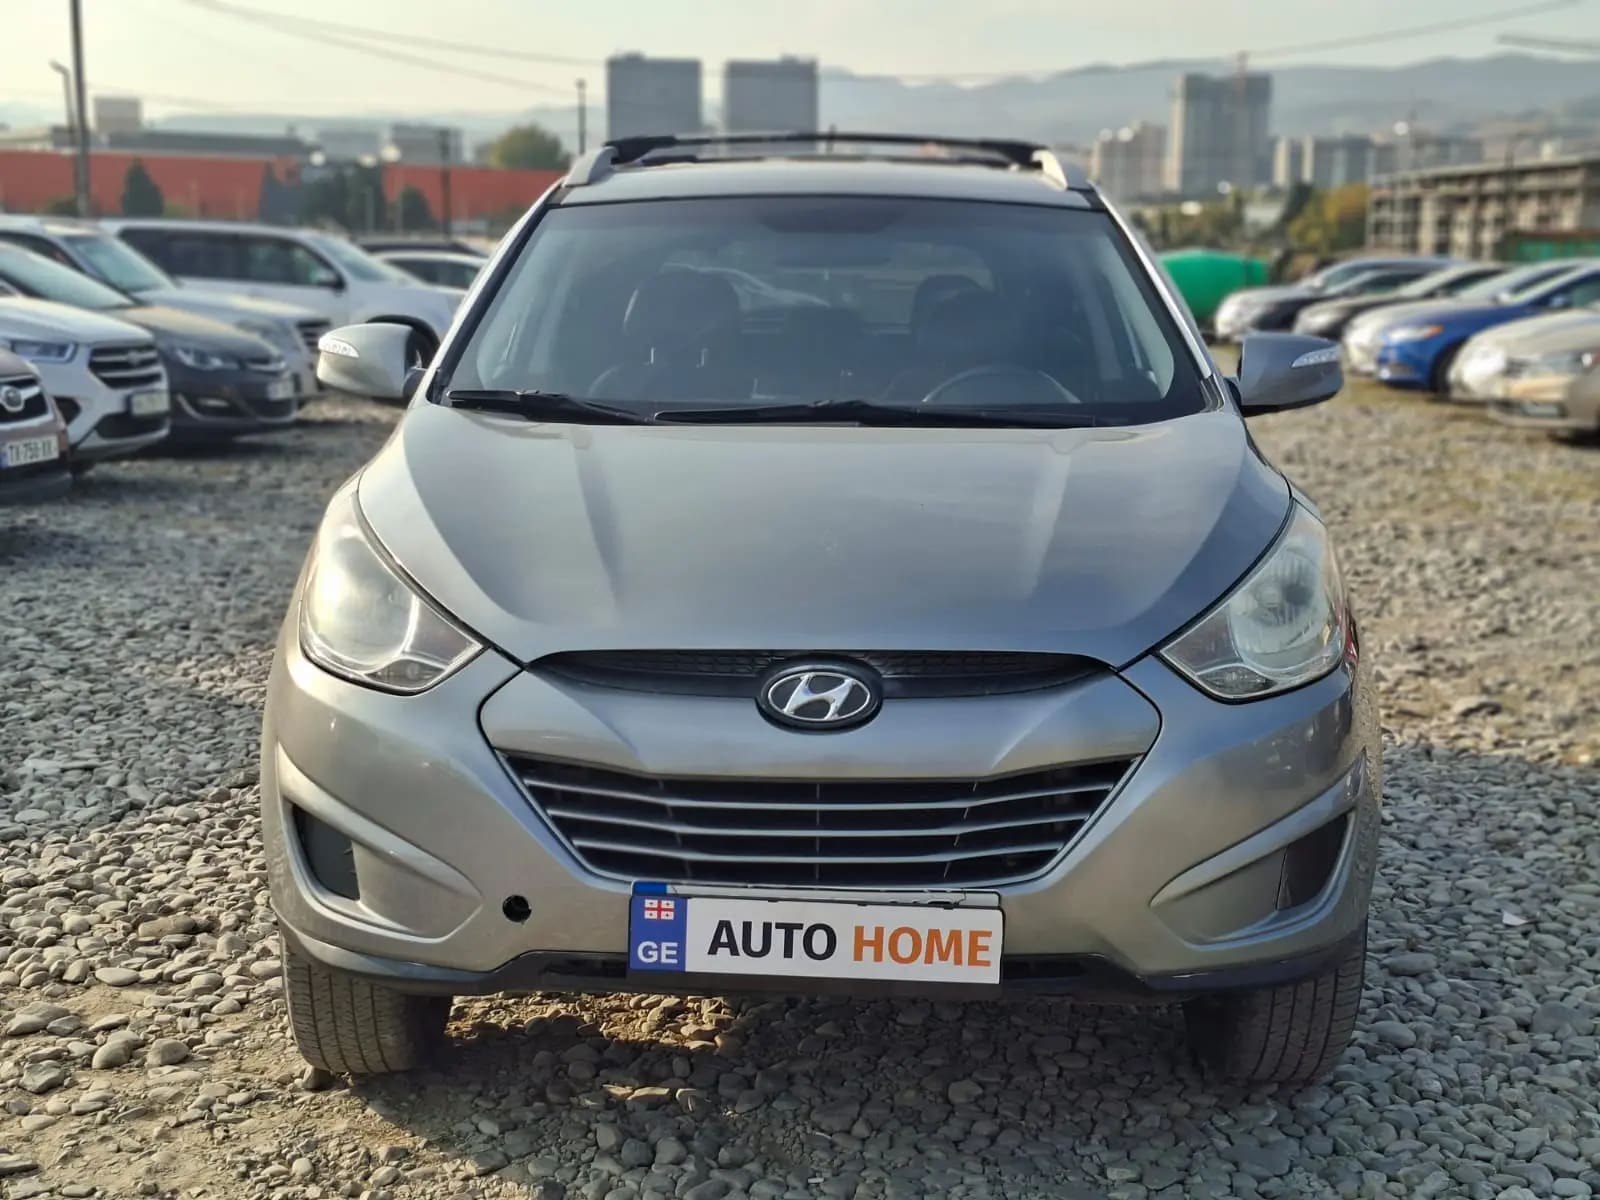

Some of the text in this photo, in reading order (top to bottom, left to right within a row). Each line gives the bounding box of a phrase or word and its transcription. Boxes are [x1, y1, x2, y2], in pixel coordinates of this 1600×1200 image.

[637, 941, 678, 964] GE
[707, 920, 993, 967] AUTO HOME
